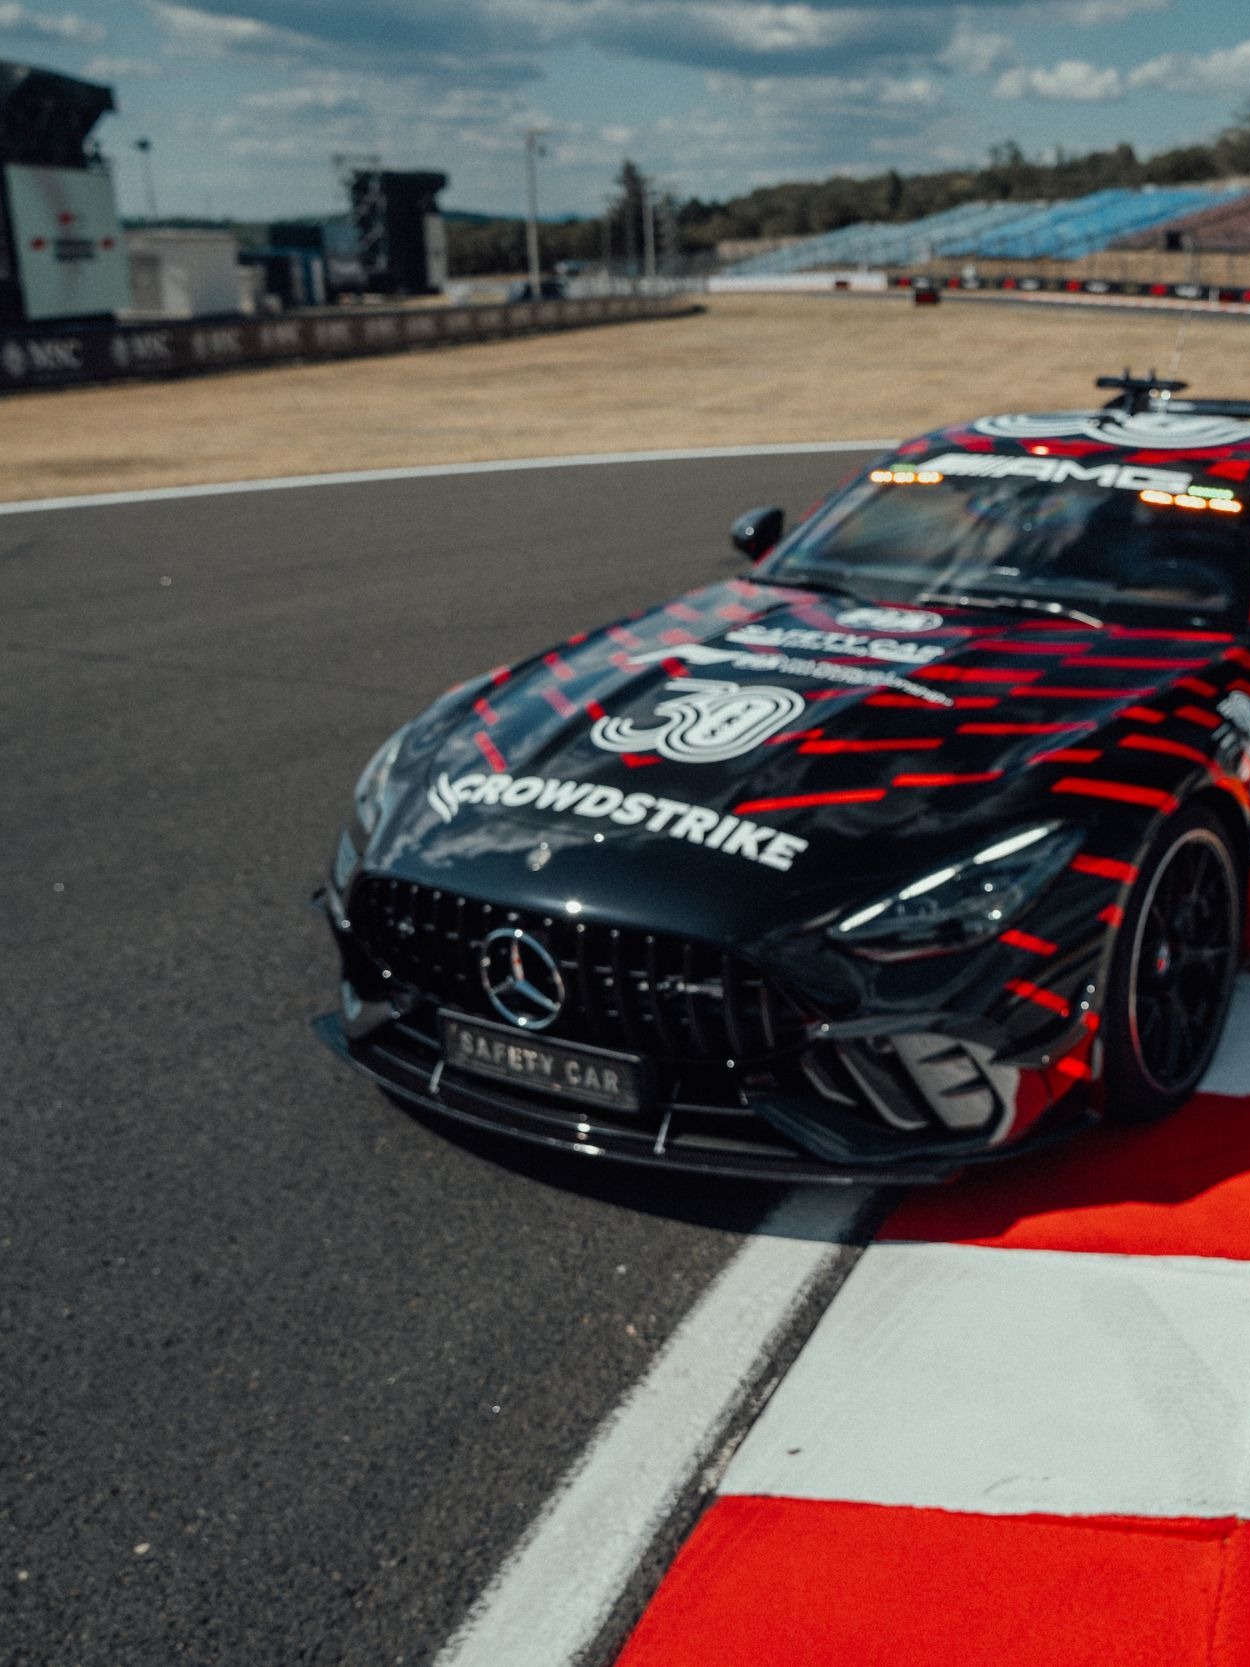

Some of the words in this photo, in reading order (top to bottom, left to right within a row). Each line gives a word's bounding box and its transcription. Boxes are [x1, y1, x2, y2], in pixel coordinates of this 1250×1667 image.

[453, 773, 809, 872] CROWDSTRIKE
[458, 1030, 554, 1076] SAFETY
[565, 1060, 619, 1094] CAR
